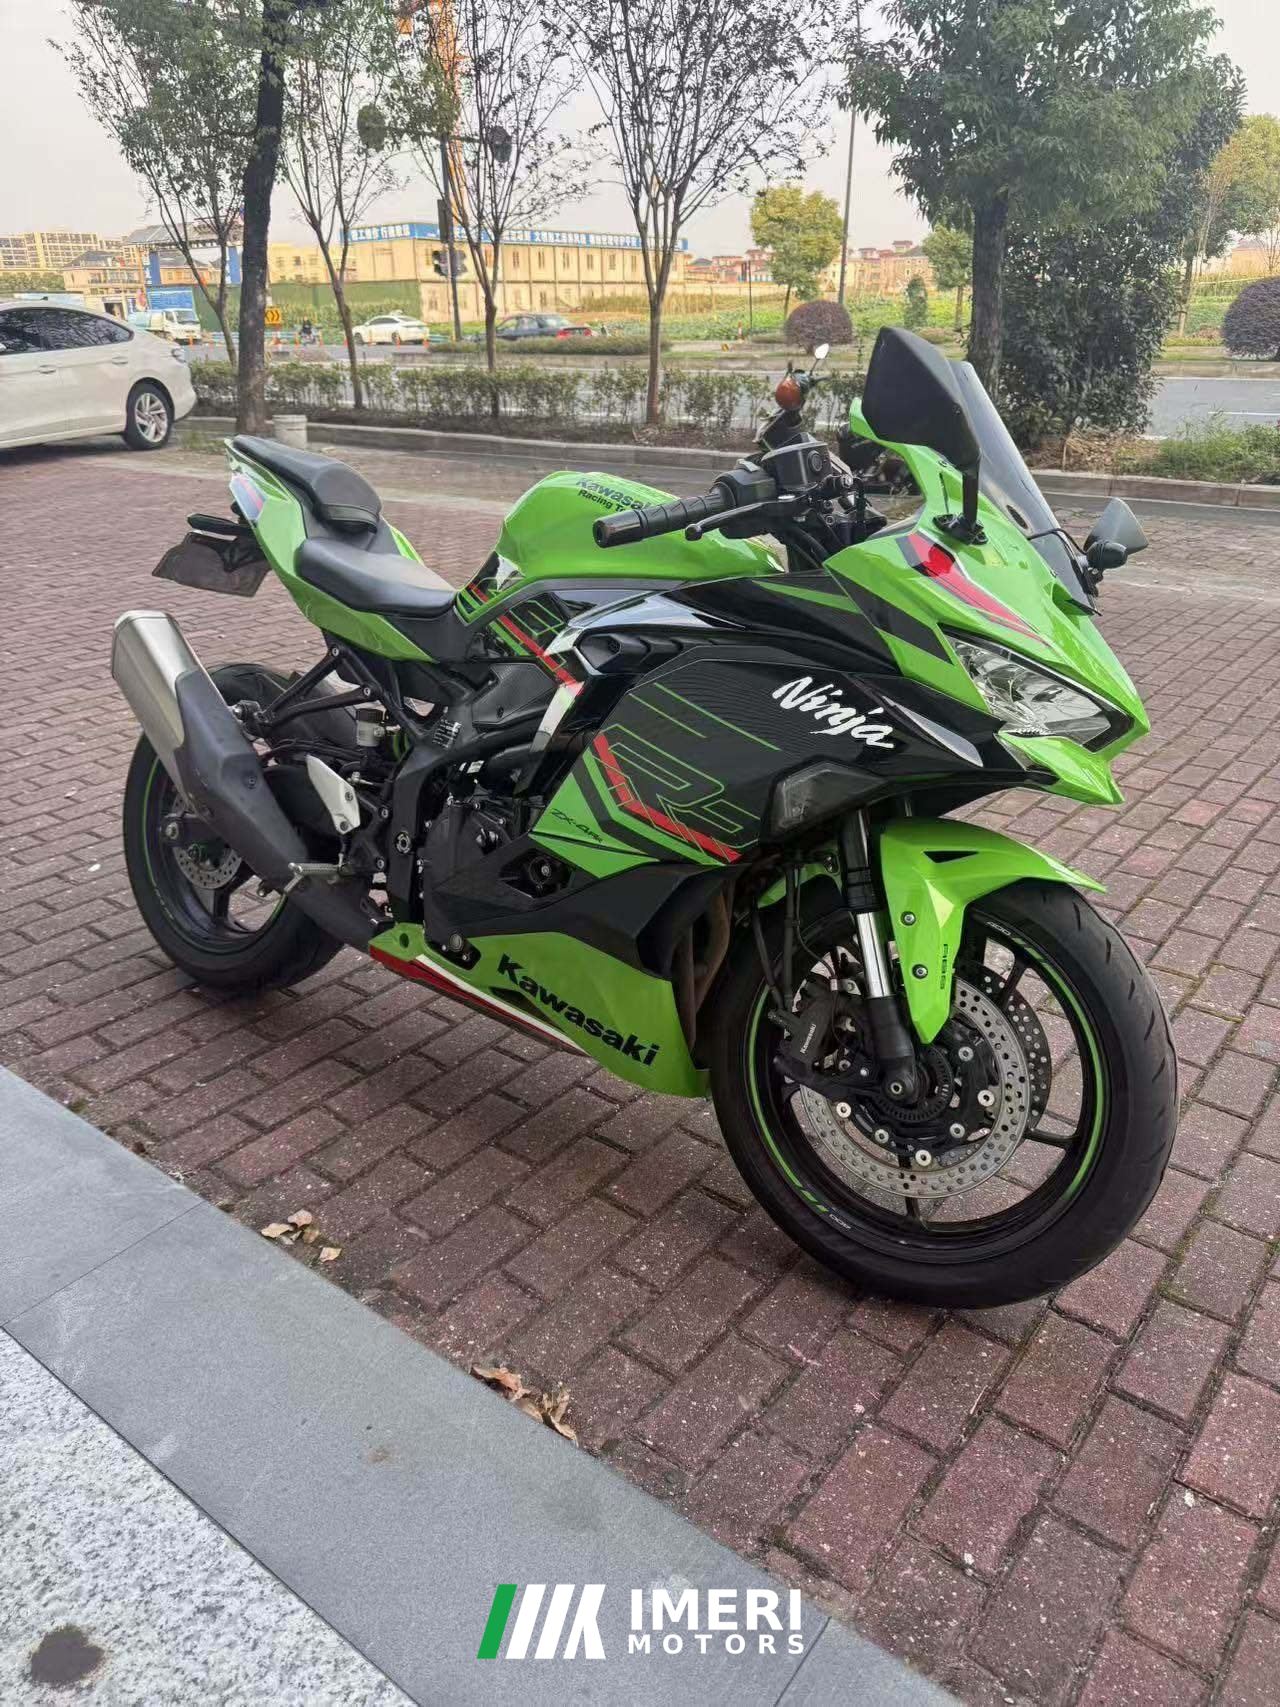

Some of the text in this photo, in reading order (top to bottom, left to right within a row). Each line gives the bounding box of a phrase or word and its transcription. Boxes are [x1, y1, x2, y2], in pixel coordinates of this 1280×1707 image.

[577, 489, 613, 509] Racing
[772, 676, 894, 748] Ninja
[497, 953, 660, 1067] Kawasaki
